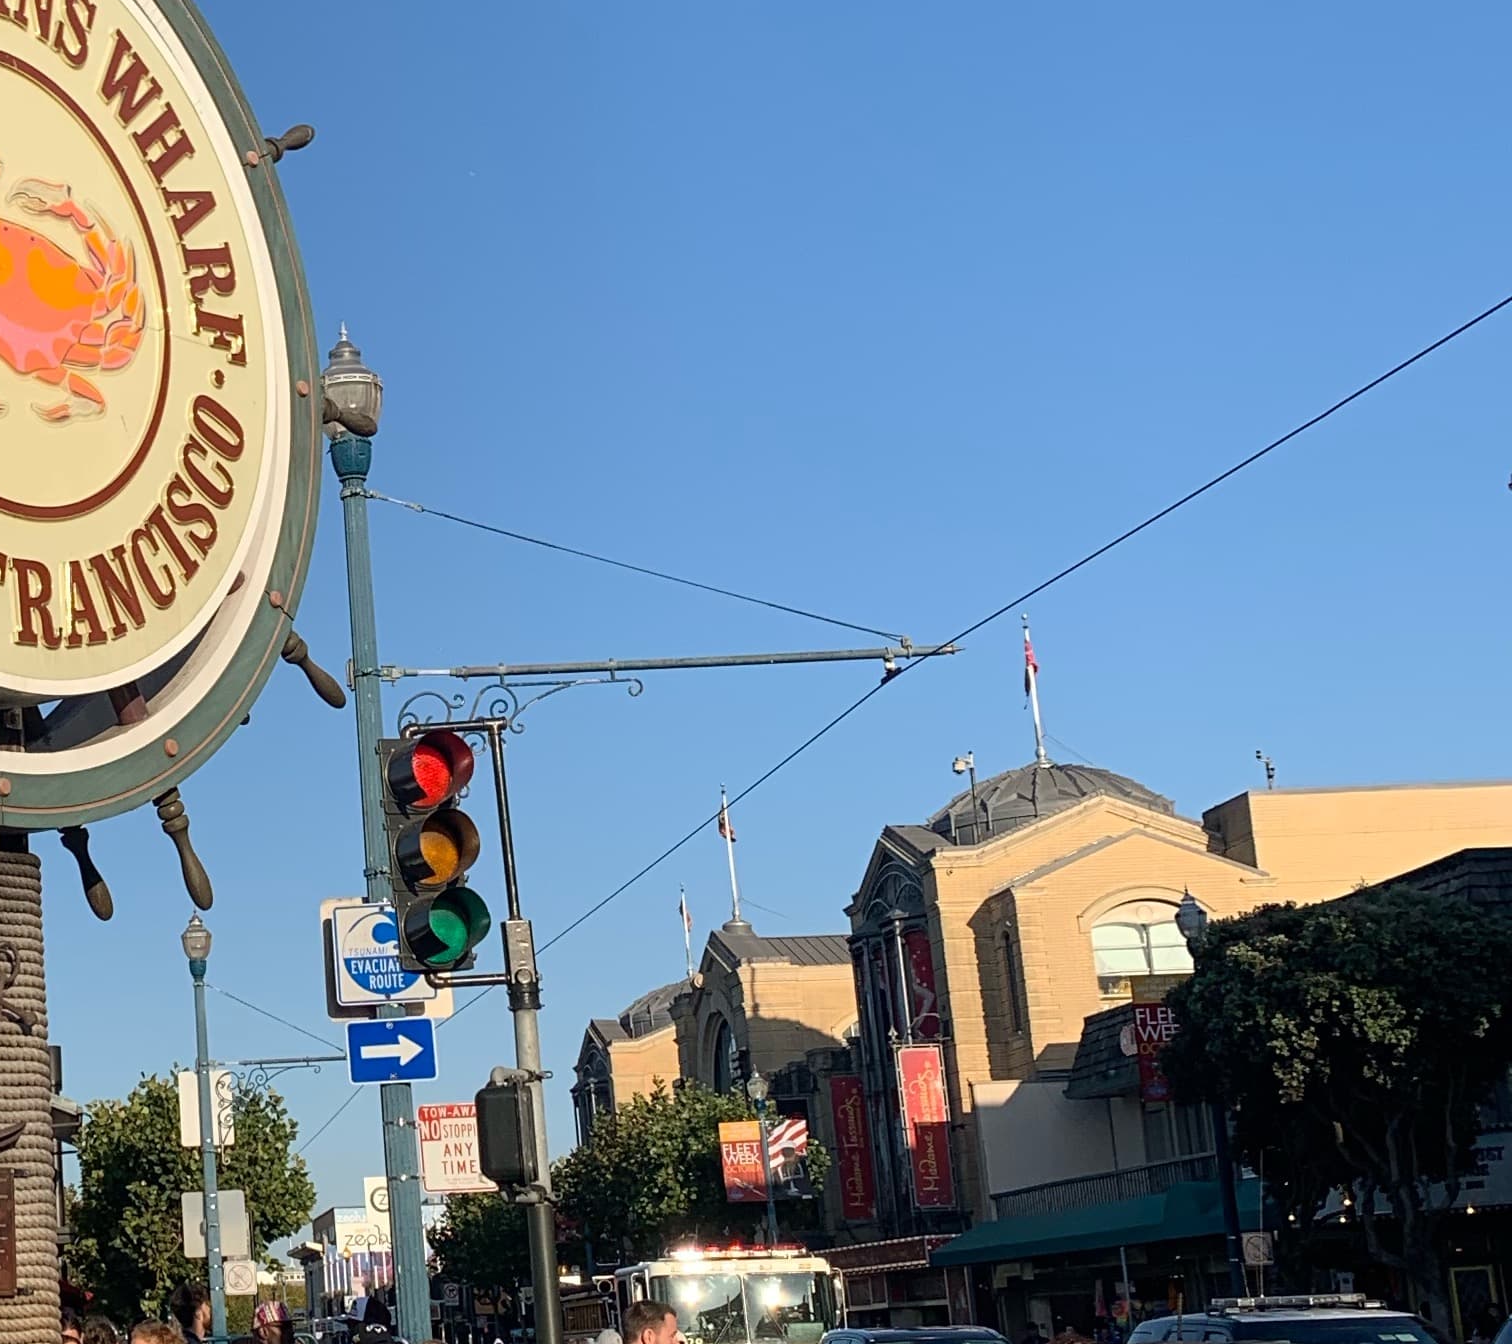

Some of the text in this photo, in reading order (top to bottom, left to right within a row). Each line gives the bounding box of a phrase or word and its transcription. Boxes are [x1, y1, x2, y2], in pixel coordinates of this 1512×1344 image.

[96, 28, 248, 367] WHARF
[351, 957, 400, 975] EVACUA
[369, 973, 406, 990] ROUTE
[420, 1119, 440, 1141] NO
[443, 1142, 473, 1158] ANY
[722, 1142, 759, 1155] FLEET
[441, 1159, 478, 1176] TIME
[723, 1153, 761, 1166] WEEK
[918, 1130, 940, 1191] Madame
[845, 1151, 865, 1207] Madame
